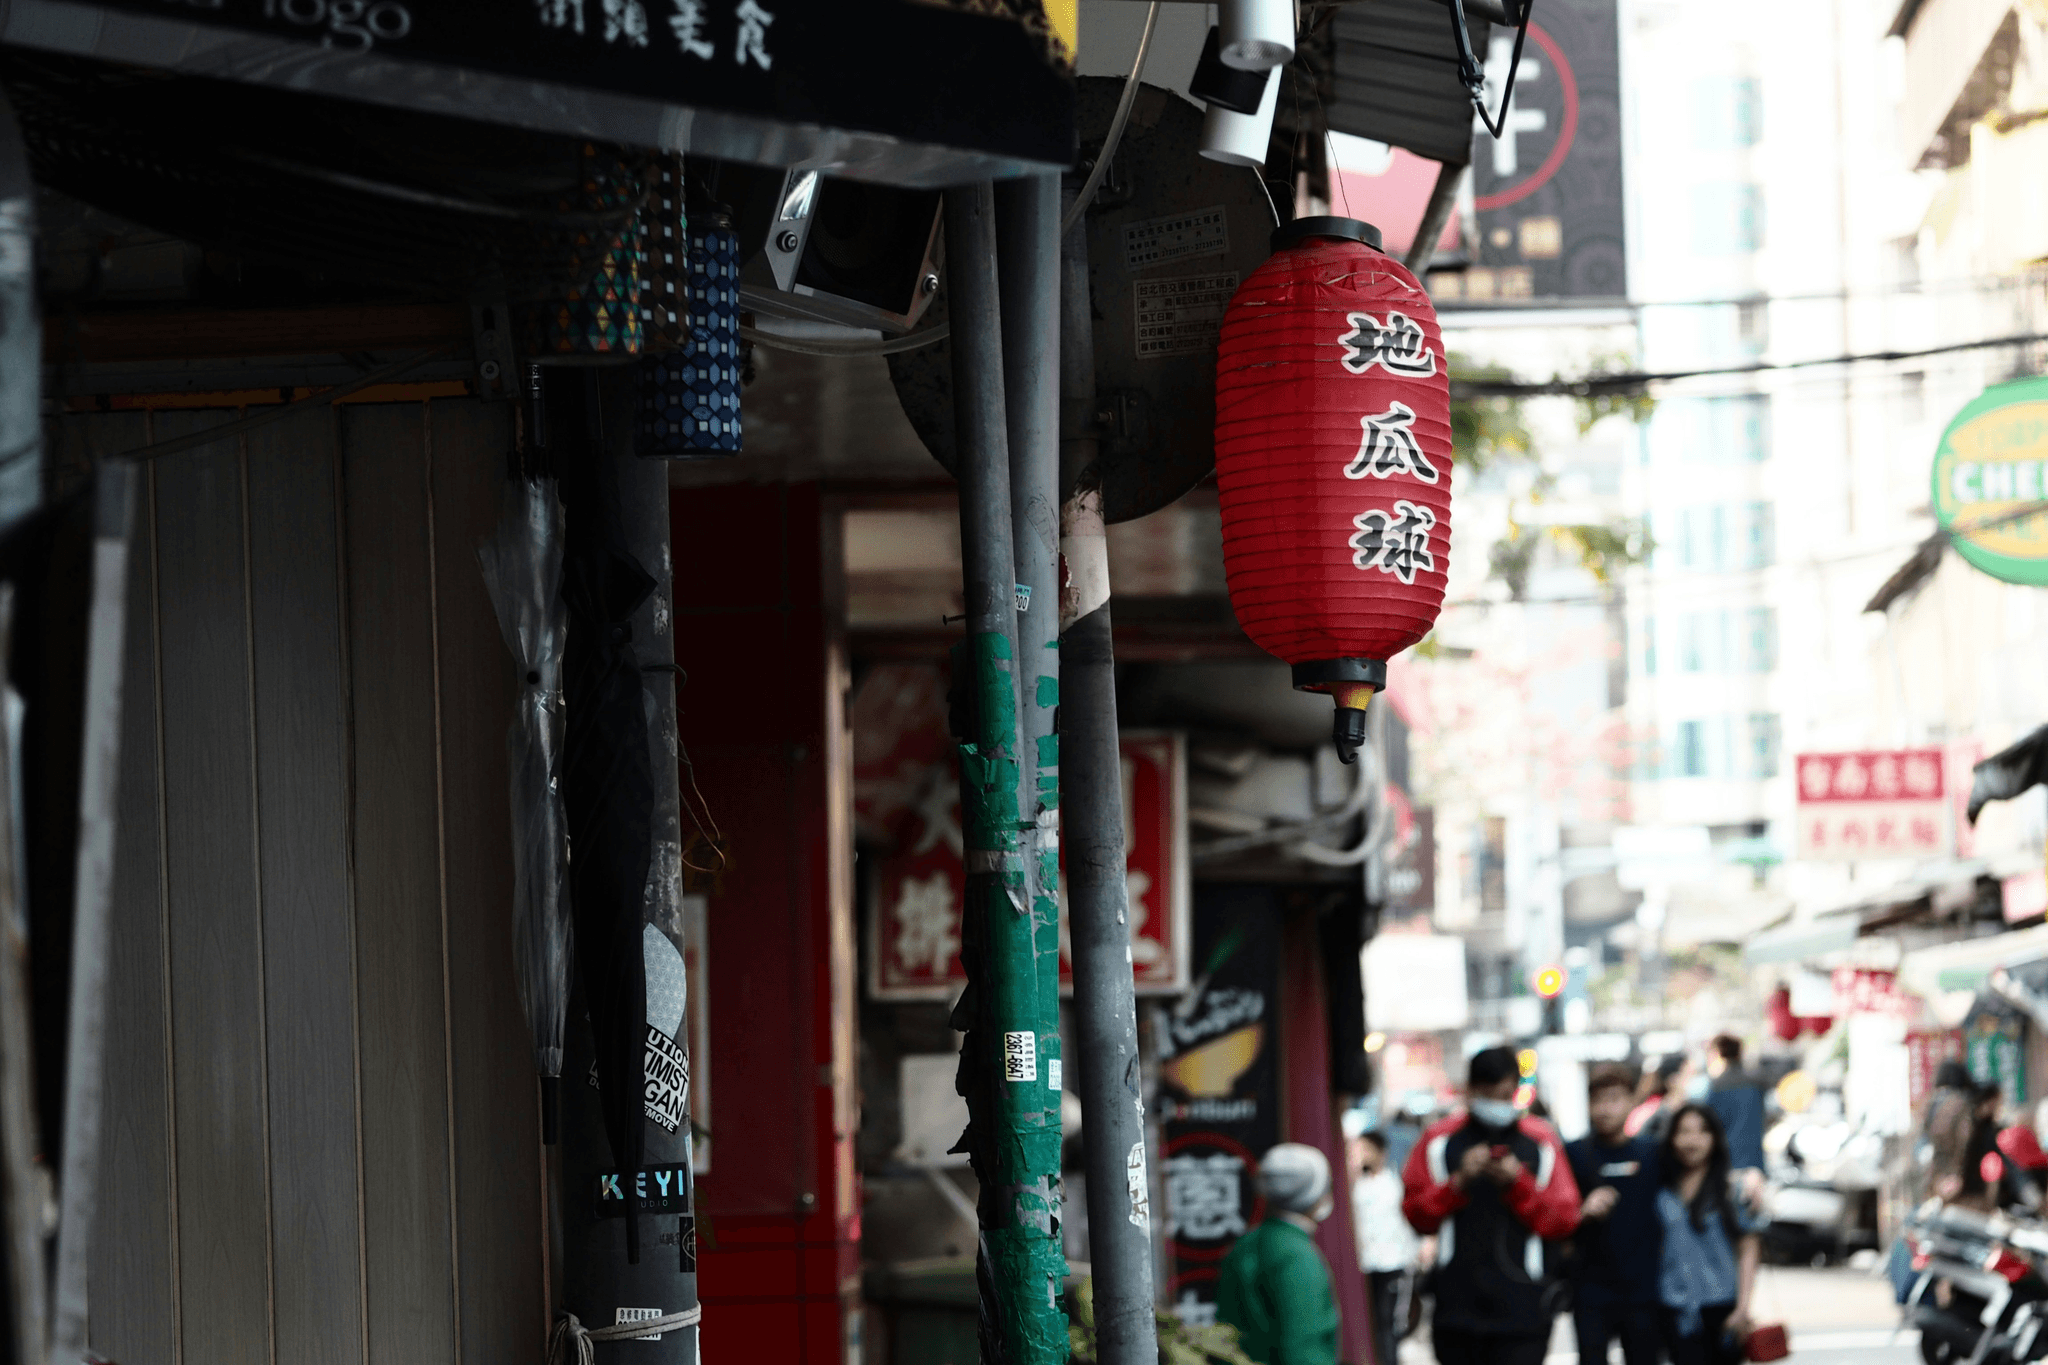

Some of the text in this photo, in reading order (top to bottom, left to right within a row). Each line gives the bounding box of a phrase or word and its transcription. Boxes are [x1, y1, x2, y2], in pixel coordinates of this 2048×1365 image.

[1139, 277, 1235, 295] 台北市交通管制工程處
[1341, 310, 1439, 584] 地瓜球
[1952, 460, 2048, 504] CHE
[647, 1028, 689, 1073] UTION
[1006, 1033, 1024, 1079] 2367-6647
[601, 1169, 684, 1200] KEYI
